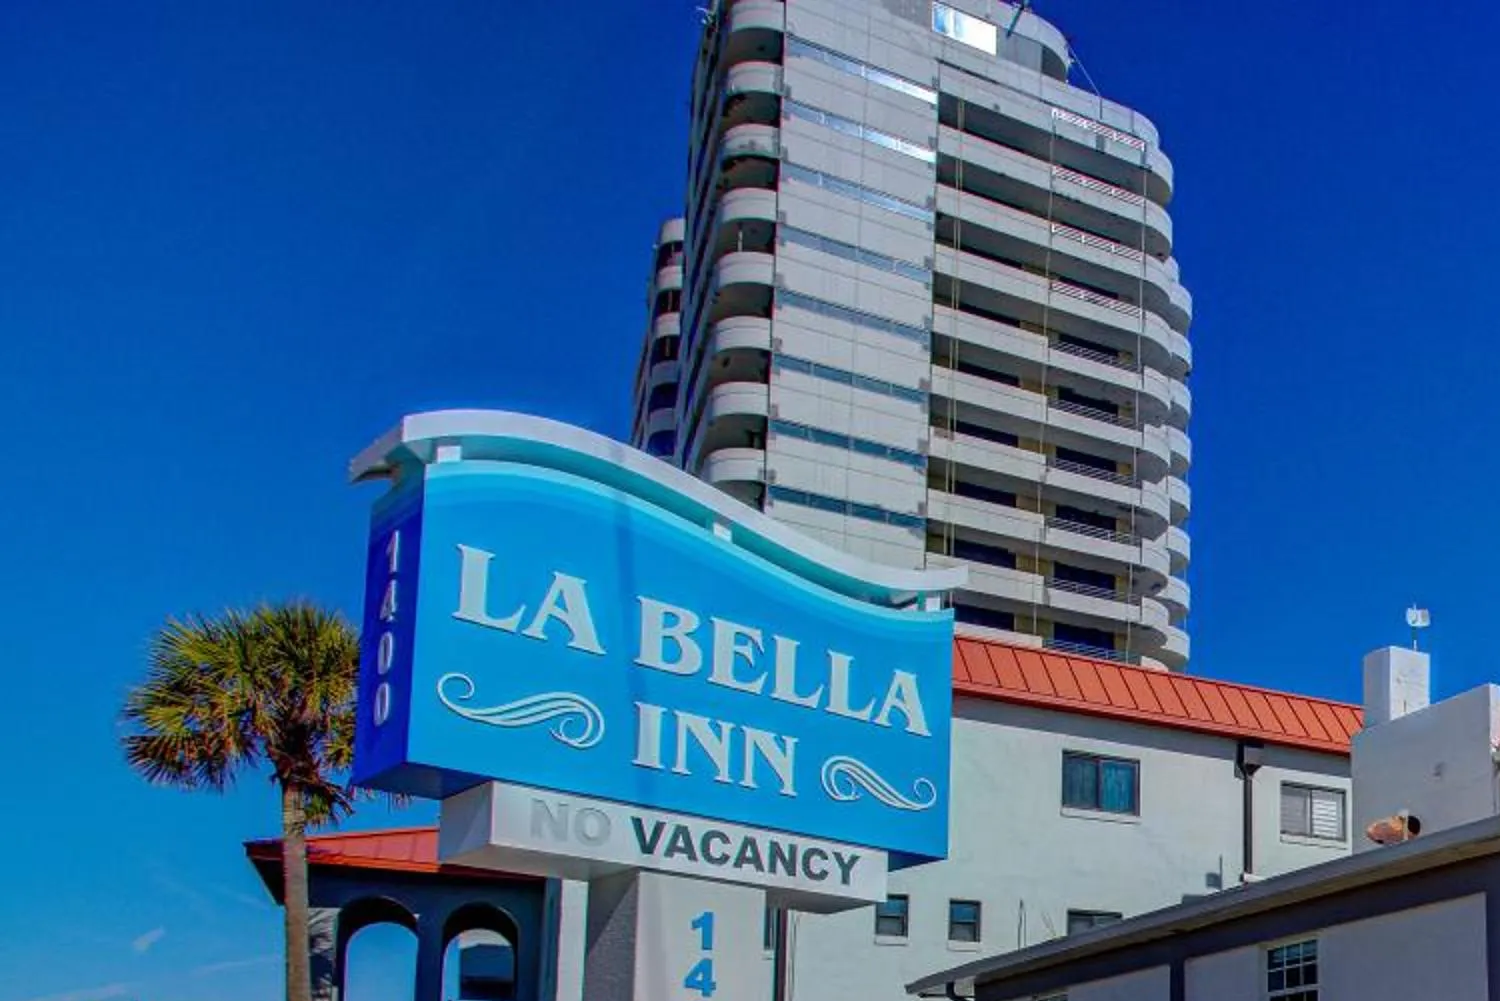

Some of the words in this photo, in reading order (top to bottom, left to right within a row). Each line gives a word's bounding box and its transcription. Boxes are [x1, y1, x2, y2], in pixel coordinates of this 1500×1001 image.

[373, 530, 400, 727] 1400
[452, 543, 606, 655] LA
[634, 595, 932, 736] BELLA
[632, 701, 799, 796] INN
[529, 797, 612, 842] NO
[631, 816, 861, 886] VACANCY
